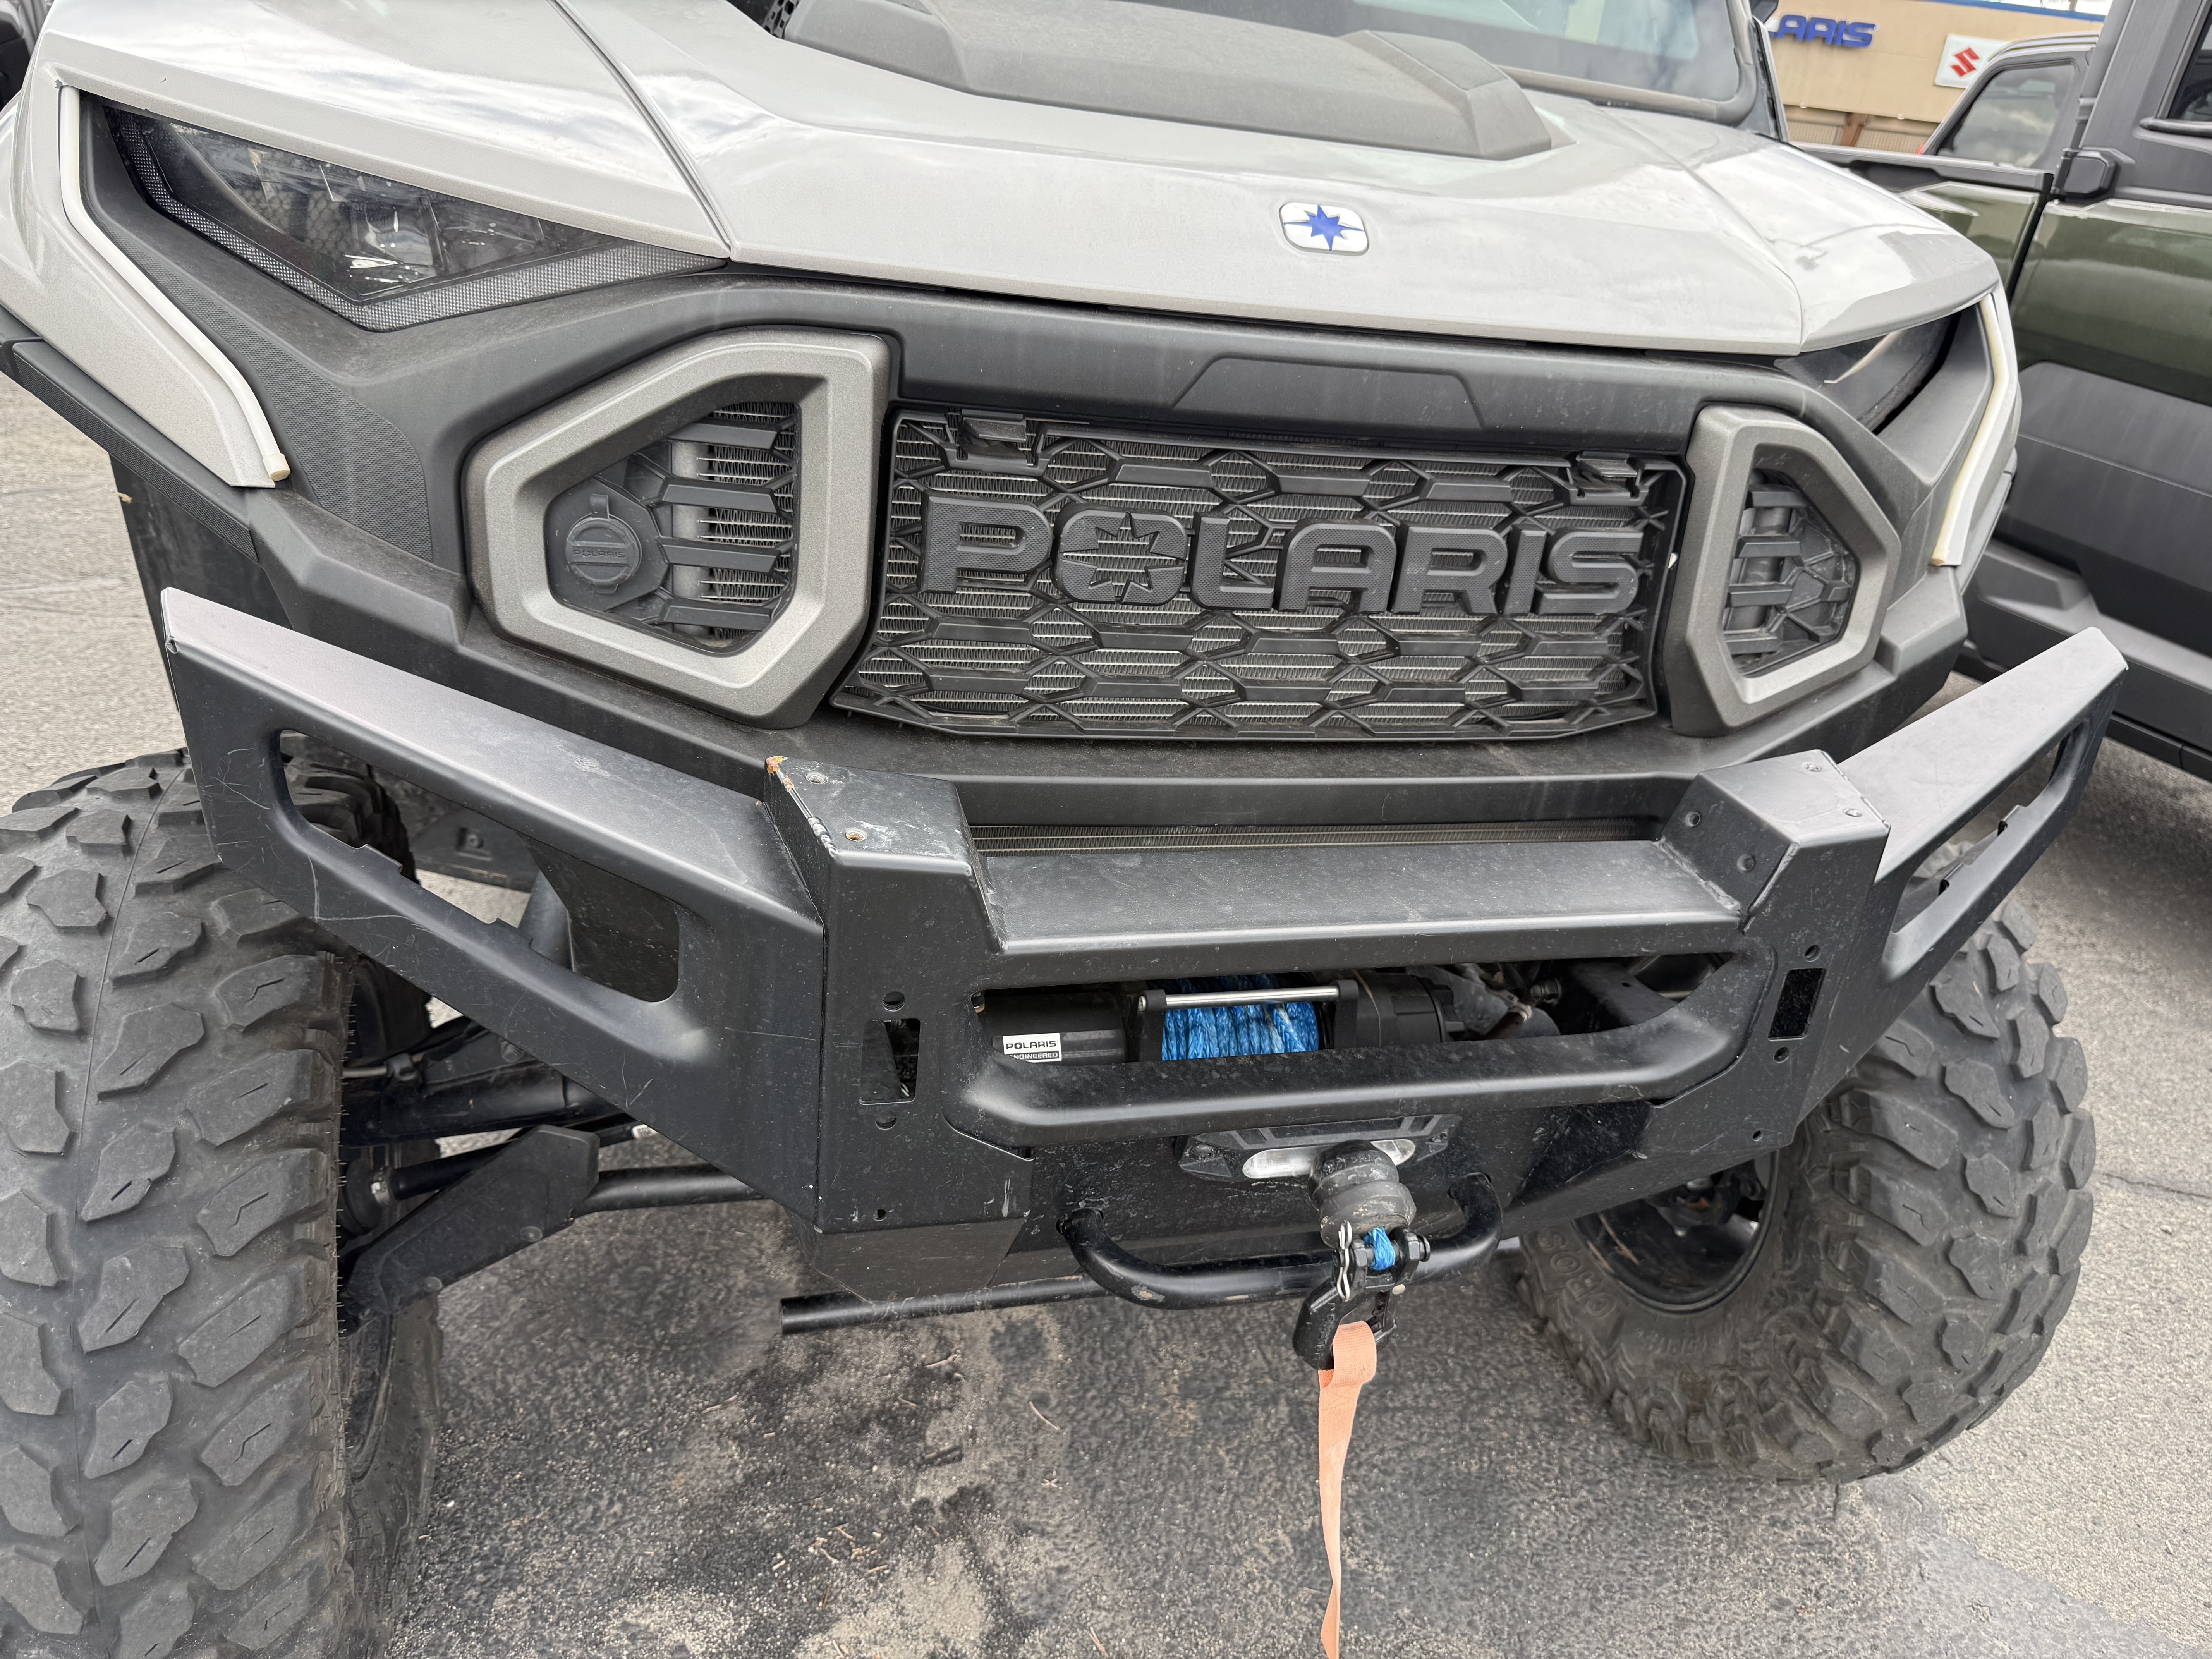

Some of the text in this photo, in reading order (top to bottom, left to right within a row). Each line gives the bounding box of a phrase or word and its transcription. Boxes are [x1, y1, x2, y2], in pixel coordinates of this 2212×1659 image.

[1768, 14, 1875, 48] ARIS
[574, 550, 626, 558] POLARIS
[922, 496, 1644, 616] POLARIS
[1006, 1041, 1056, 1049] POLARIS
